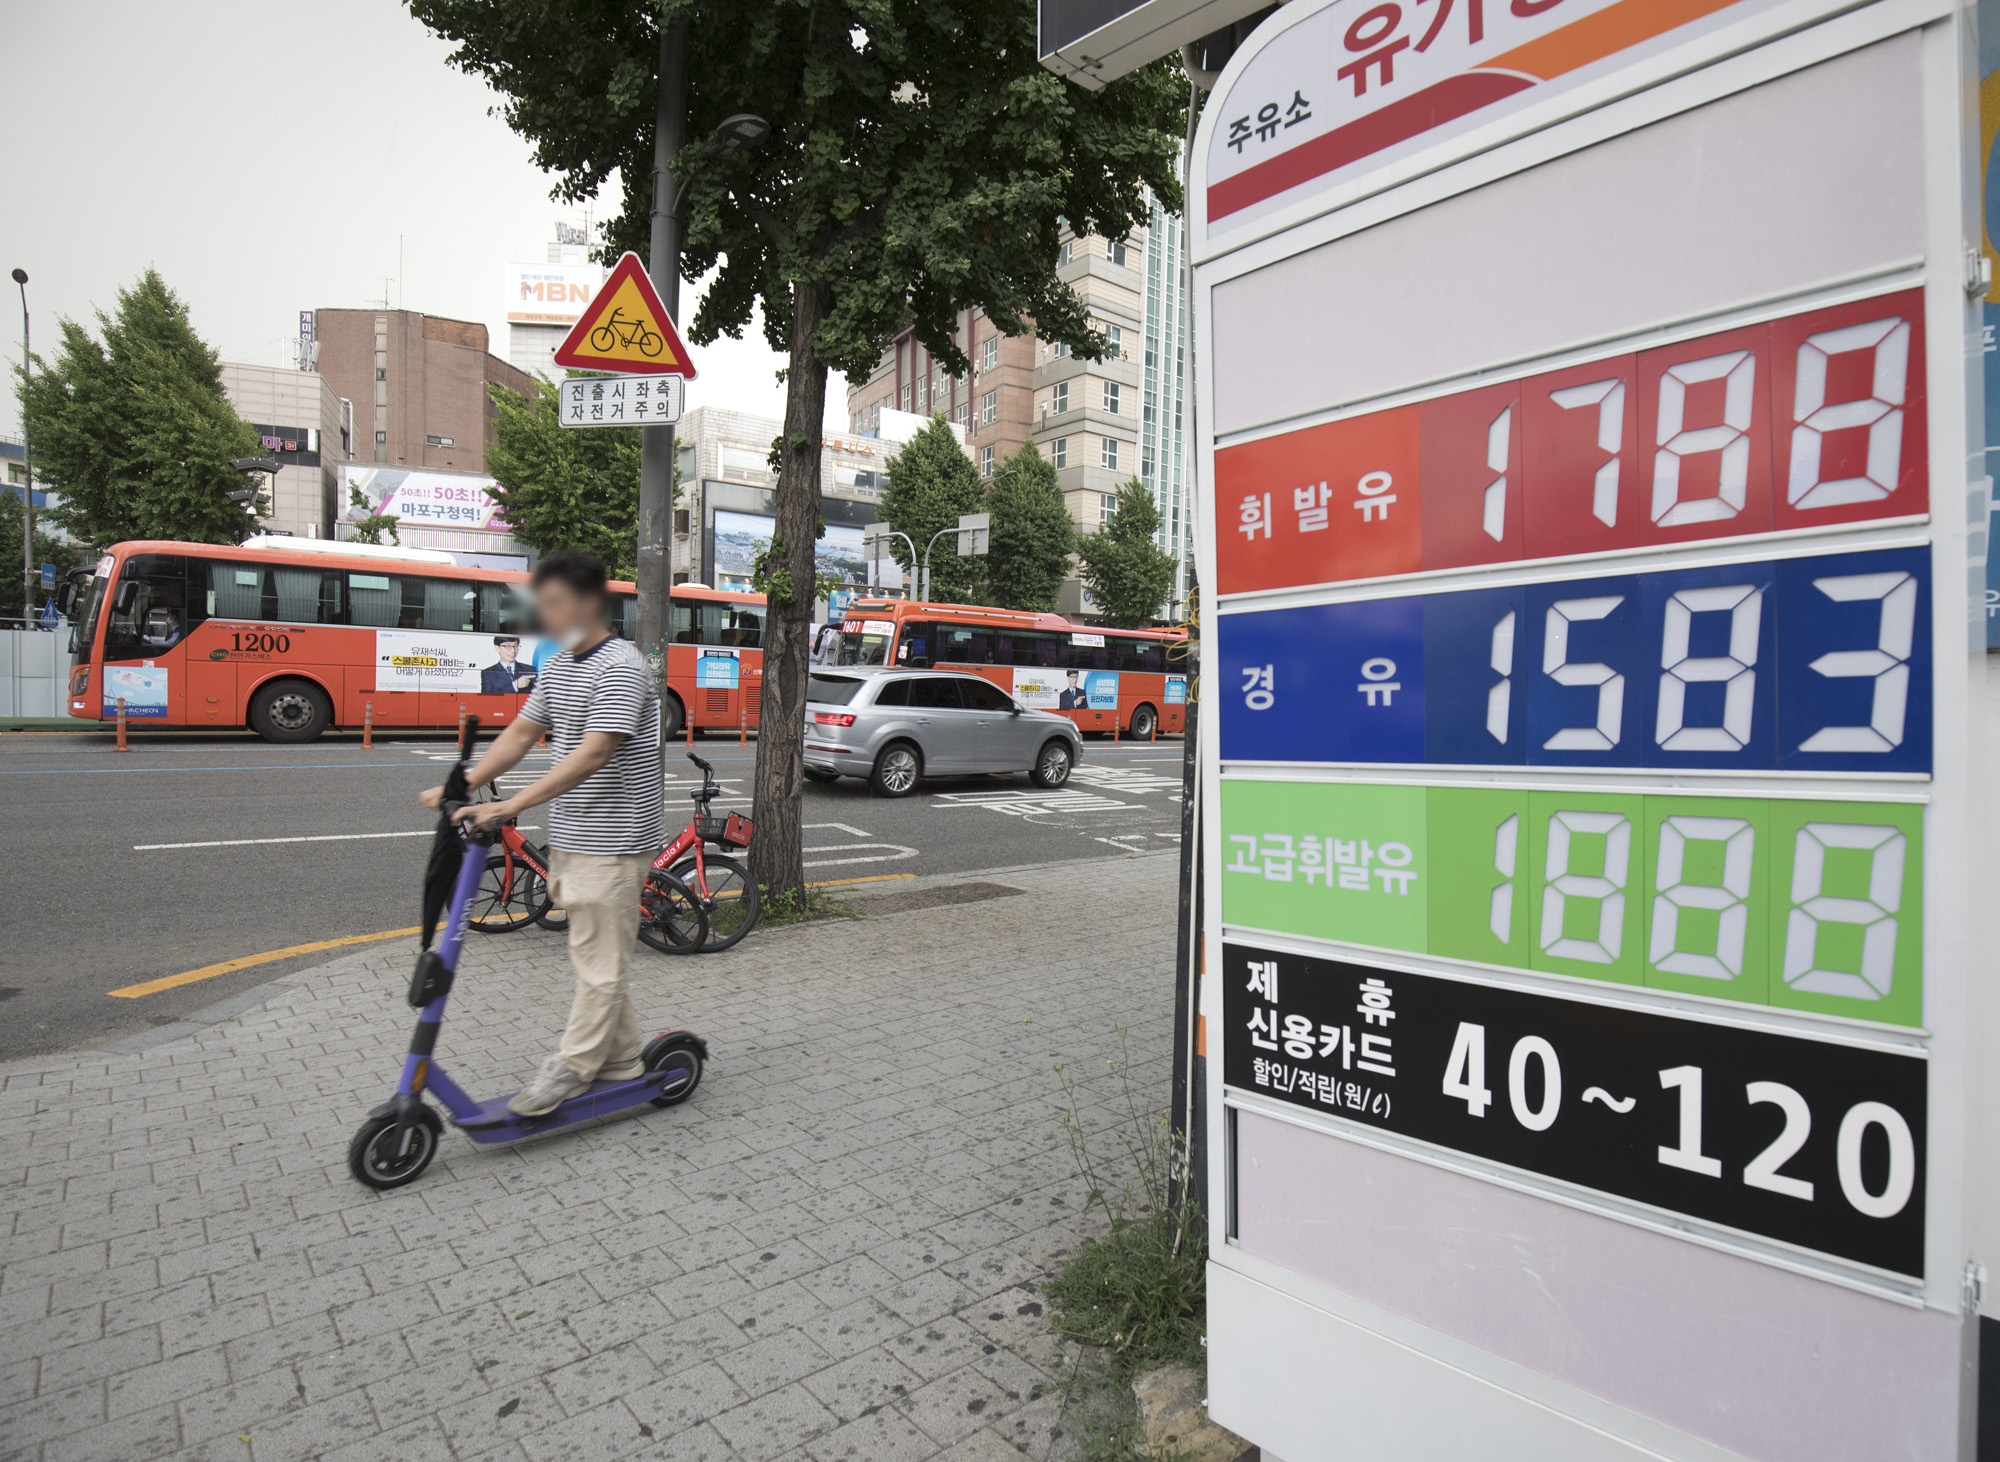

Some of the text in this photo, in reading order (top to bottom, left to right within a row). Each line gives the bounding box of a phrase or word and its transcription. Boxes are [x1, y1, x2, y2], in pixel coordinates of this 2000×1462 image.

[1227, 90, 1312, 154] 주유소
[520, 281, 590, 303] MBN
[571, 380, 671, 401] 진출시 좌측
[571, 400, 670, 421] 자전거 주의
[1482, 315, 1911, 542] 1788
[400, 486, 482, 503] 50초!! 50초!!
[401, 502, 481, 521] 마포구청역!
[842, 620, 861, 633] 1601
[231, 632, 290, 653] 1200
[1485, 570, 1918, 753] 1583
[1226, 809, 1908, 1000] 고급휘발유 1888
[1246, 1006, 1396, 1077] 신용카드
